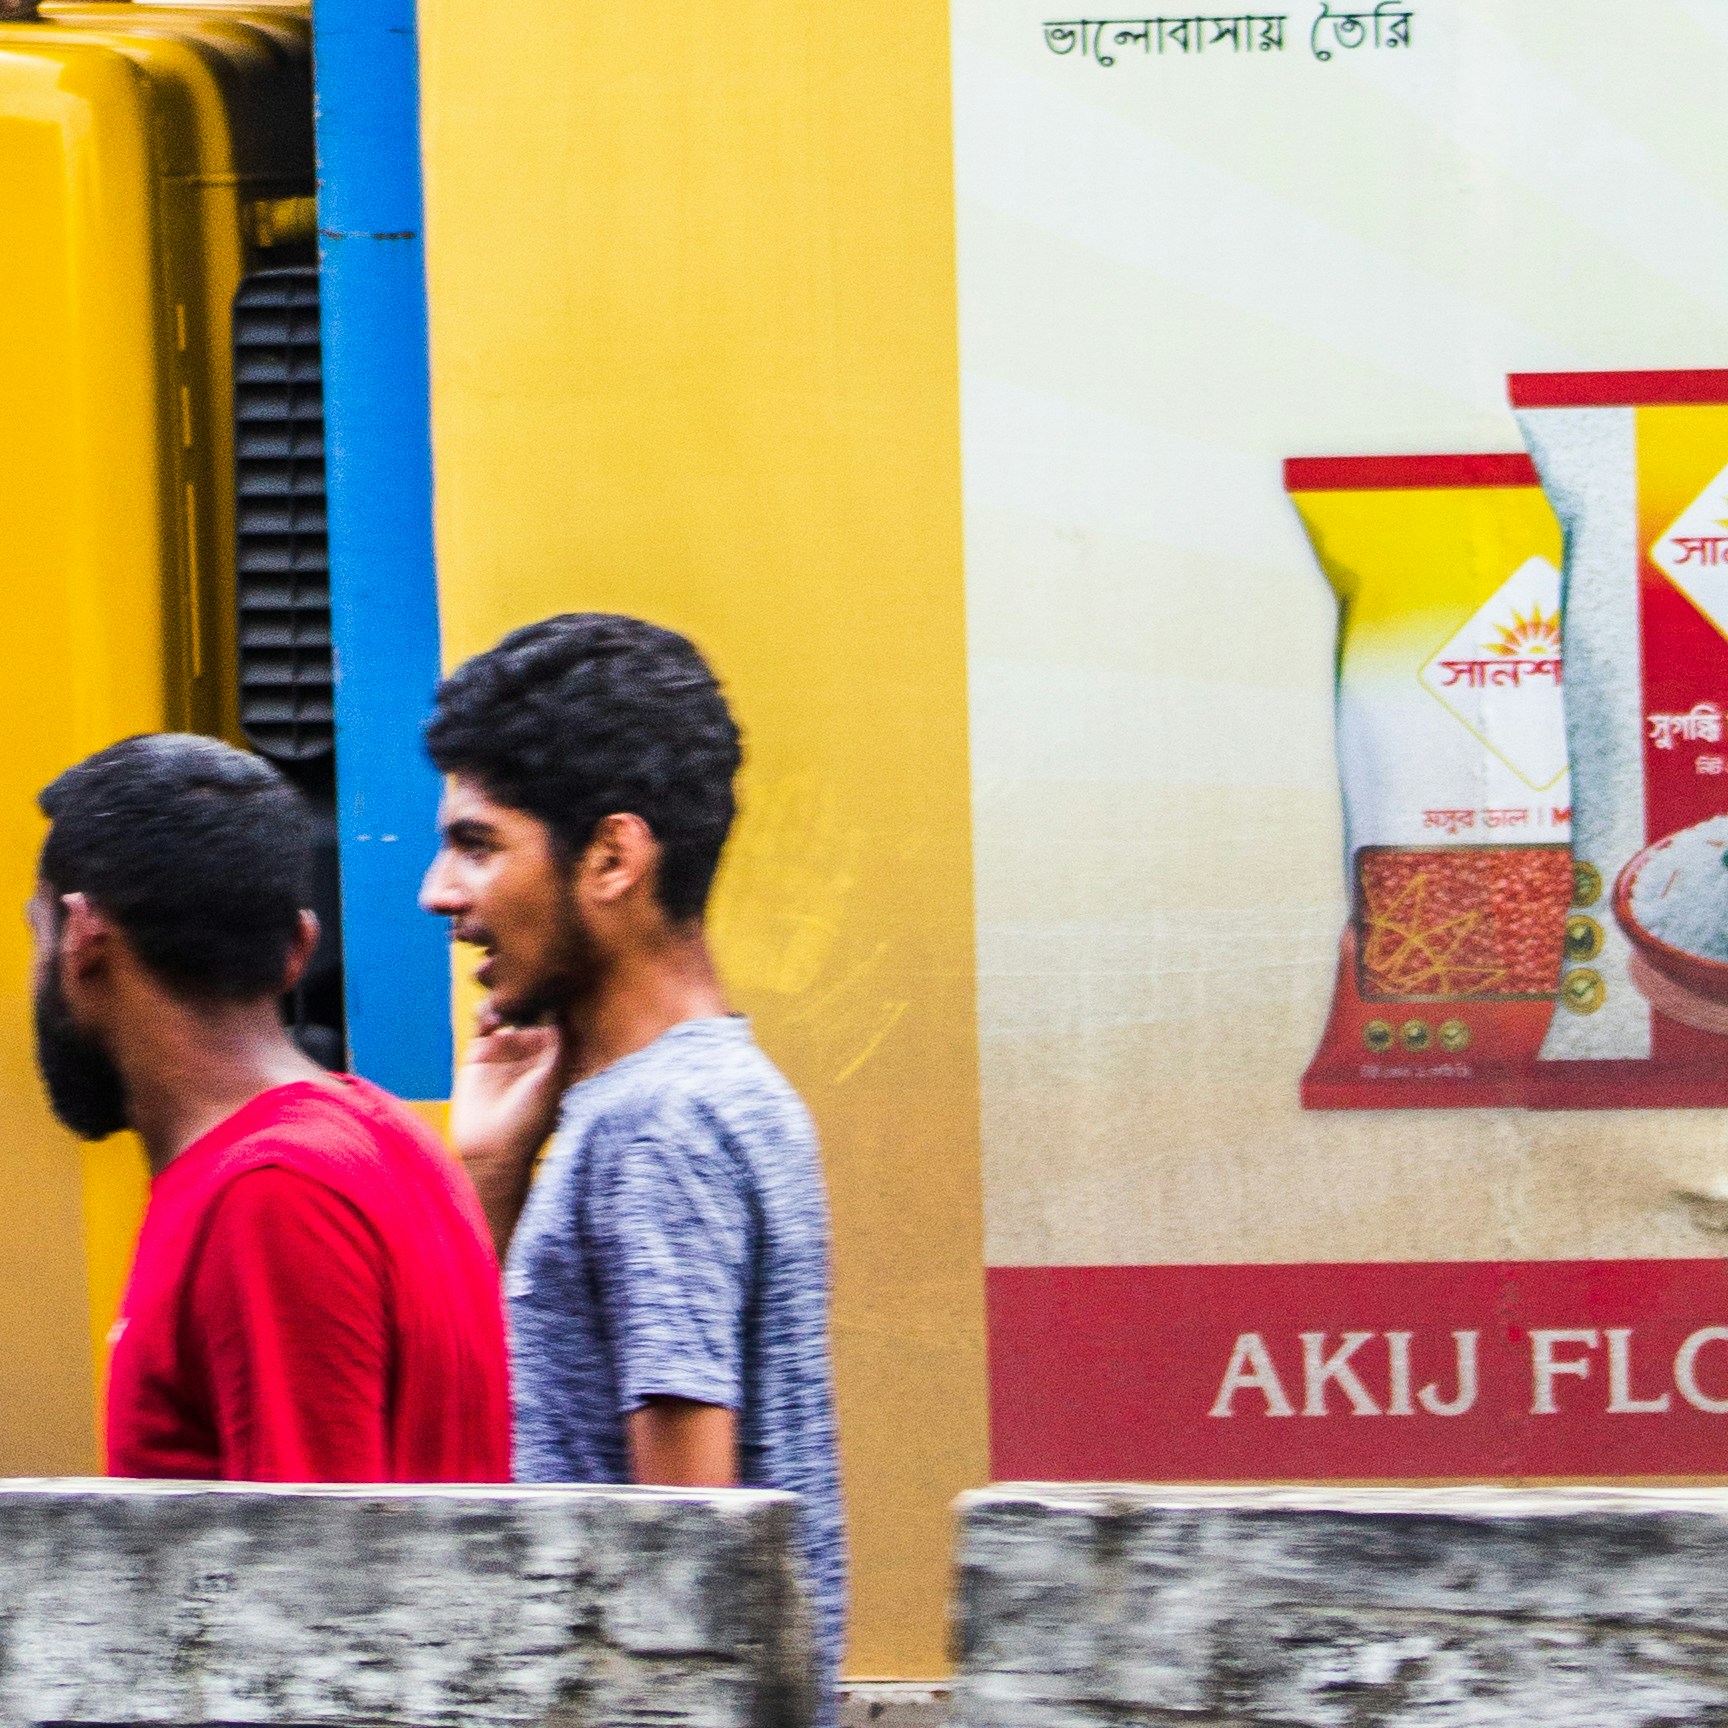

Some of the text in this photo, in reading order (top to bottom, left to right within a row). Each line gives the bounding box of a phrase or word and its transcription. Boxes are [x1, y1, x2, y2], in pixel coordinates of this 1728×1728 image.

[1042, 0, 1414, 67] ভালোবাসায় তৈরি
[1670, 536, 1728, 566] সা
[1207, 1326, 1728, 1418] AKIJ FLO
